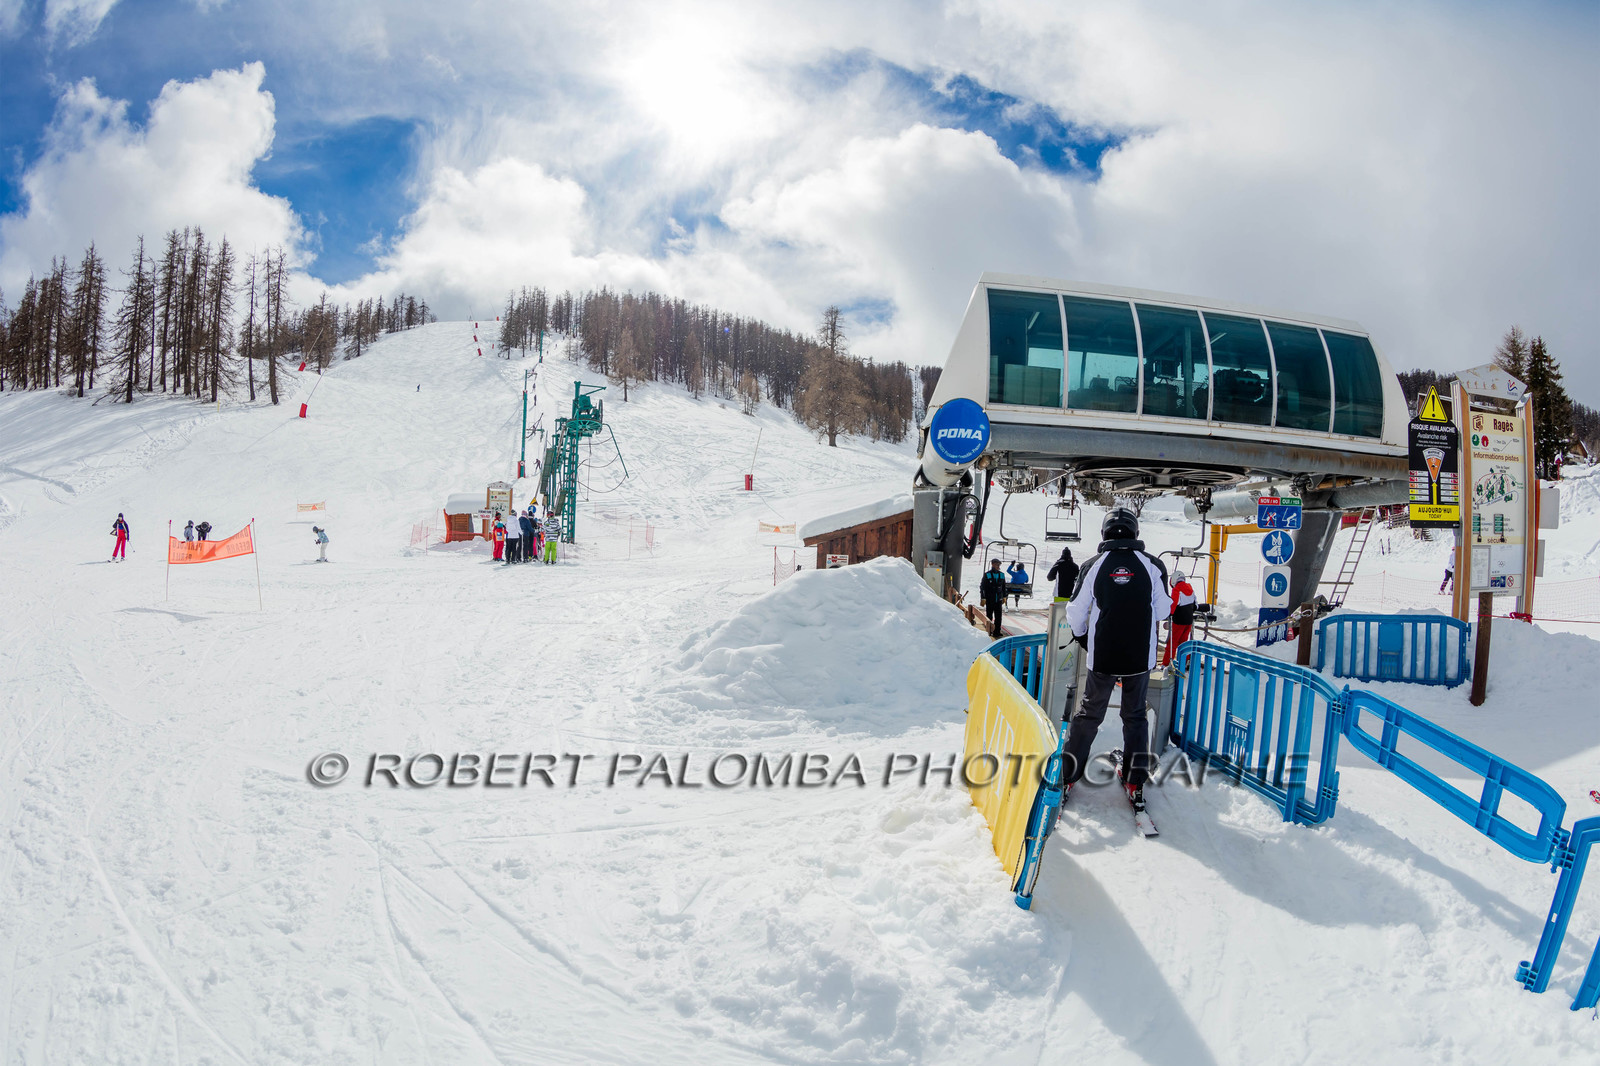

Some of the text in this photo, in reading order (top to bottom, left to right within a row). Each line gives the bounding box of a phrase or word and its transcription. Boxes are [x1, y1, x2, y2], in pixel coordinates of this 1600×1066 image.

[1410, 423, 1456, 434] RISQUE AVALANCHE
[937, 428, 982, 441] POMA
[1416, 432, 1439, 440] Avalanche
[1473, 451, 1519, 462] Informations pistes
[1418, 506, 1452, 514] AUJOURD'HUI
